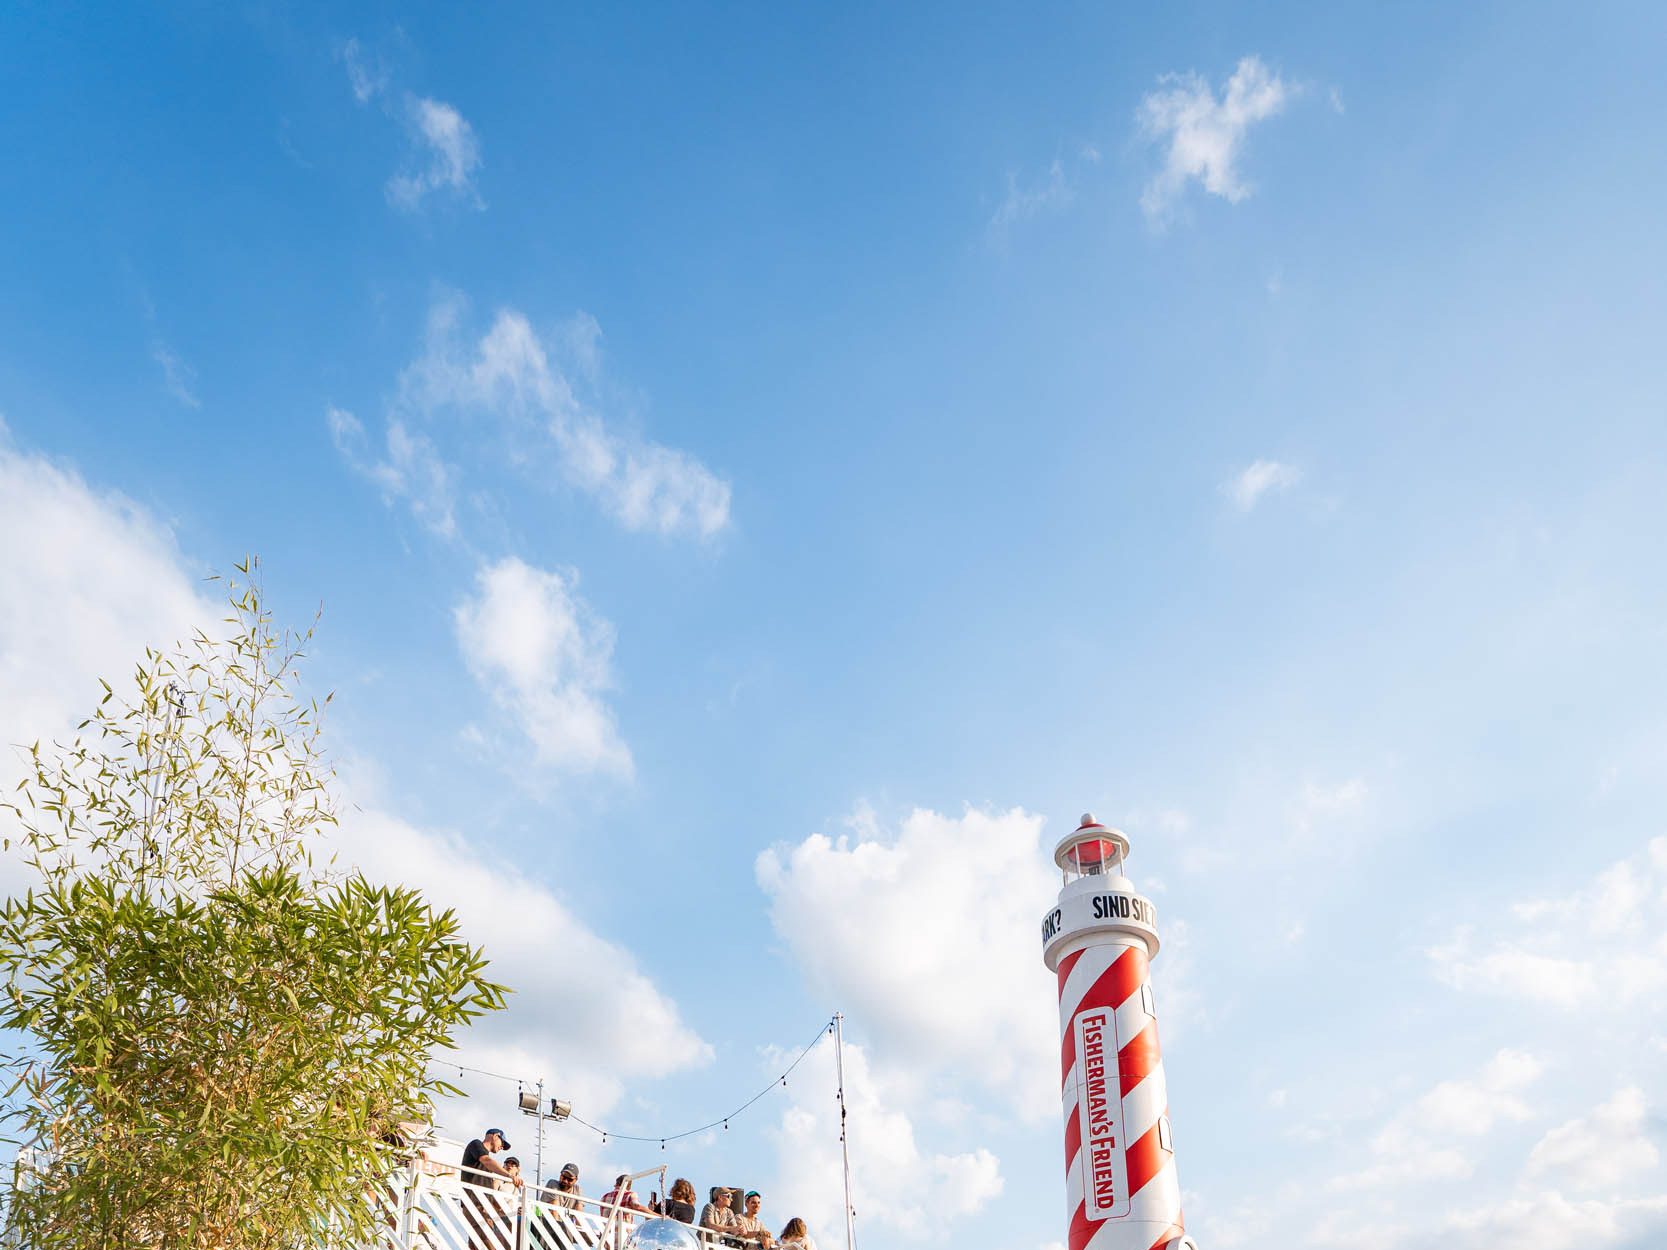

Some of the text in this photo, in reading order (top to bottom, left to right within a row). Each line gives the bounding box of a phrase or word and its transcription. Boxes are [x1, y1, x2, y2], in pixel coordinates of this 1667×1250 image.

[1093, 895, 1130, 919] SIND
[1042, 908, 1062, 945] ARK?
[1082, 1014, 1115, 1209] FISHERMAN'S FRIEND
